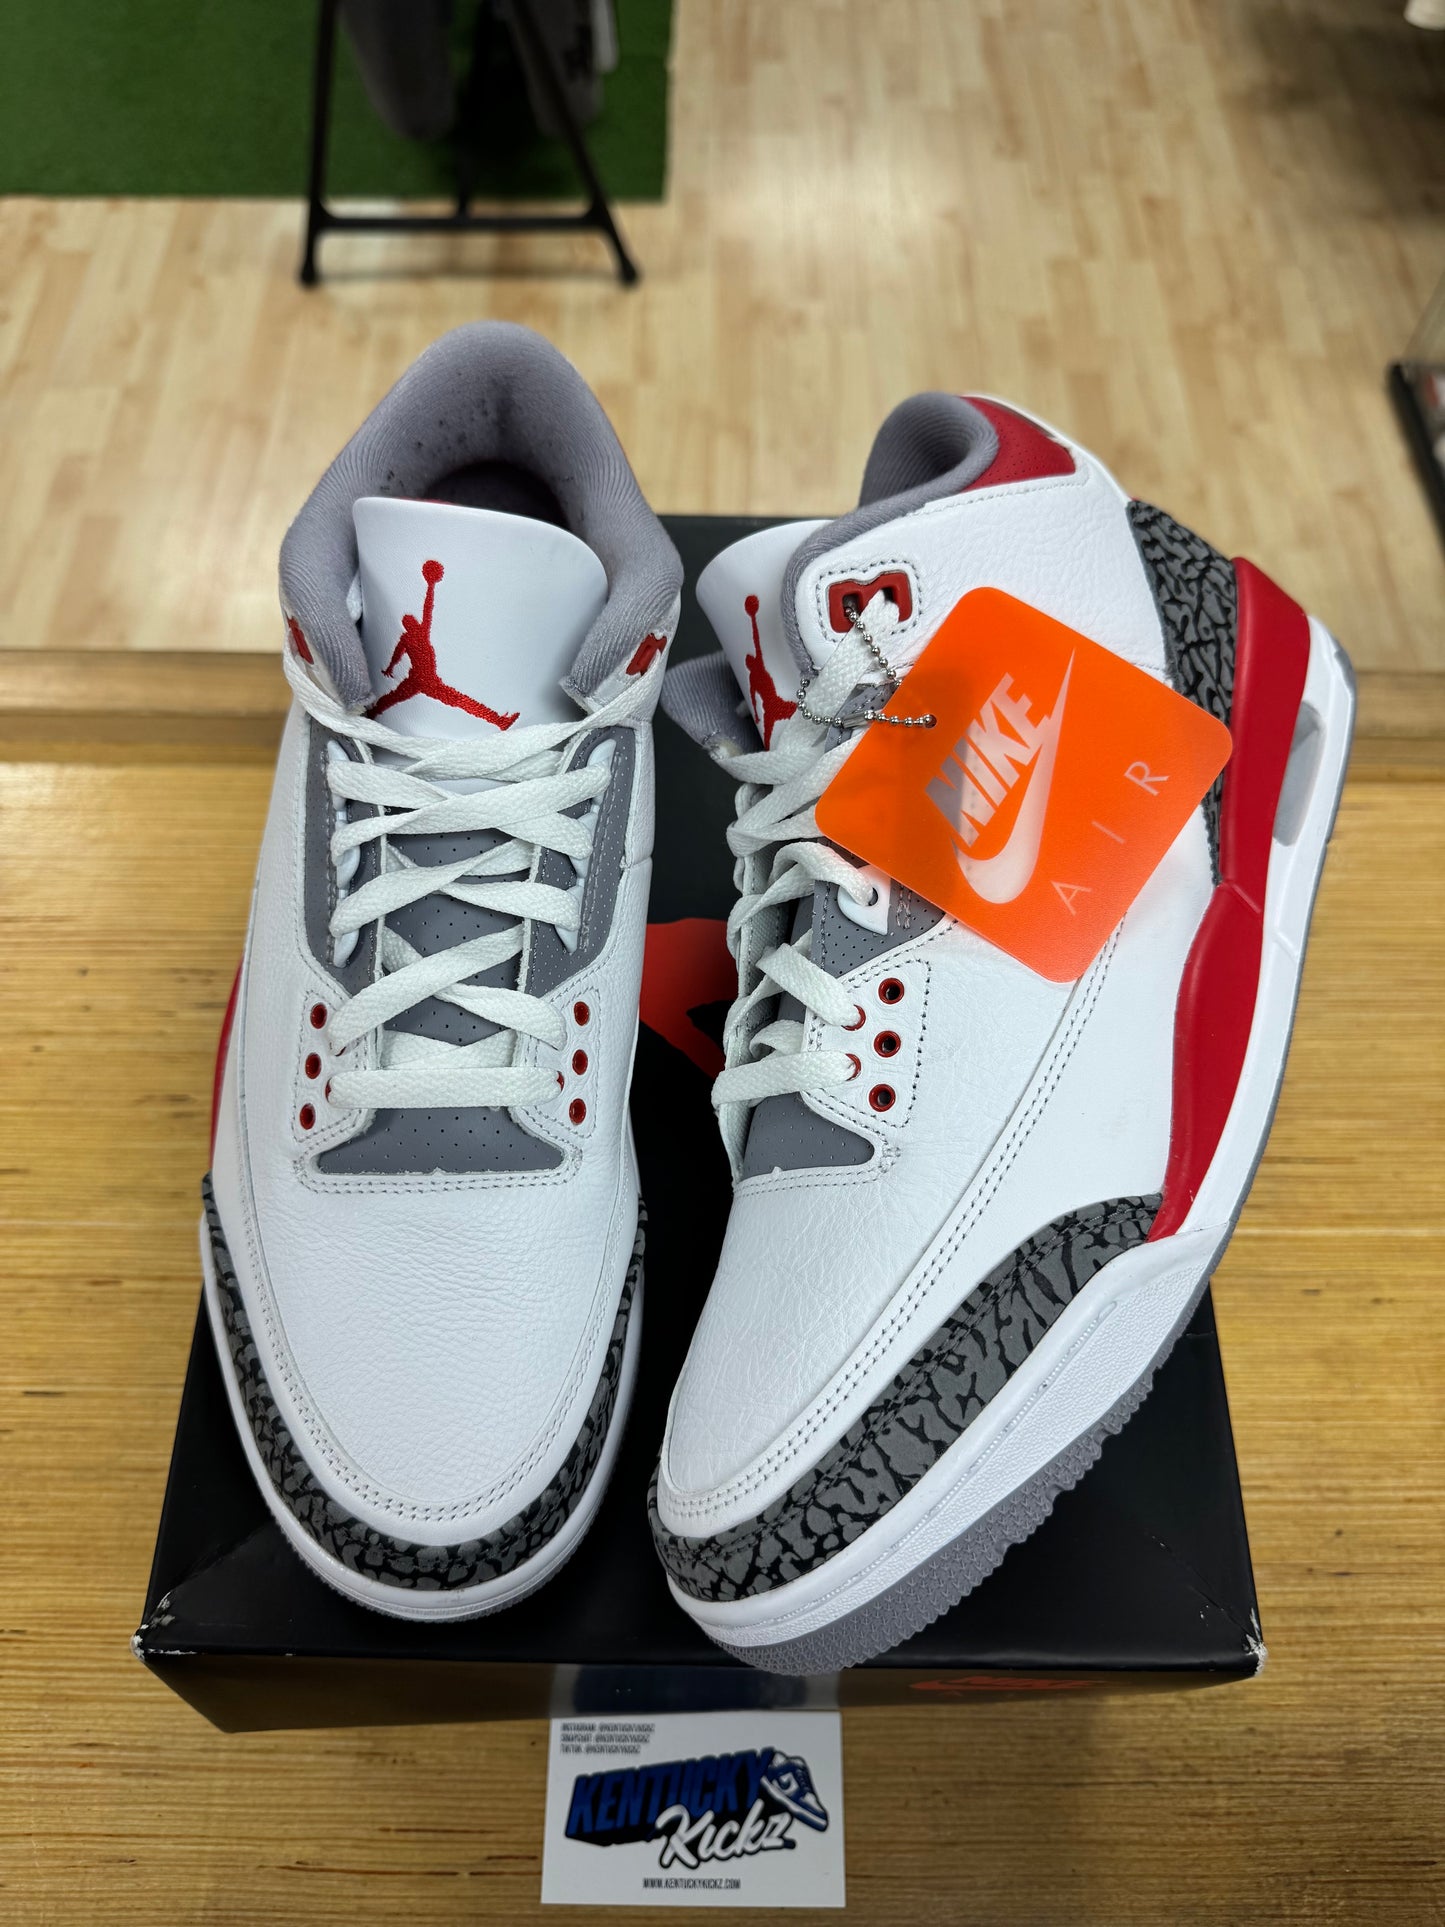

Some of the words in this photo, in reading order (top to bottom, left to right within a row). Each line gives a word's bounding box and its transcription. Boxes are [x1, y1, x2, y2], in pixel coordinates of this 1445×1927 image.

[925, 672, 1052, 848] NIKE
[566, 1747, 774, 1837] KENTUCKY
[643, 1877, 741, 1889] WWW.KENTUCKYKICKZ.COM
